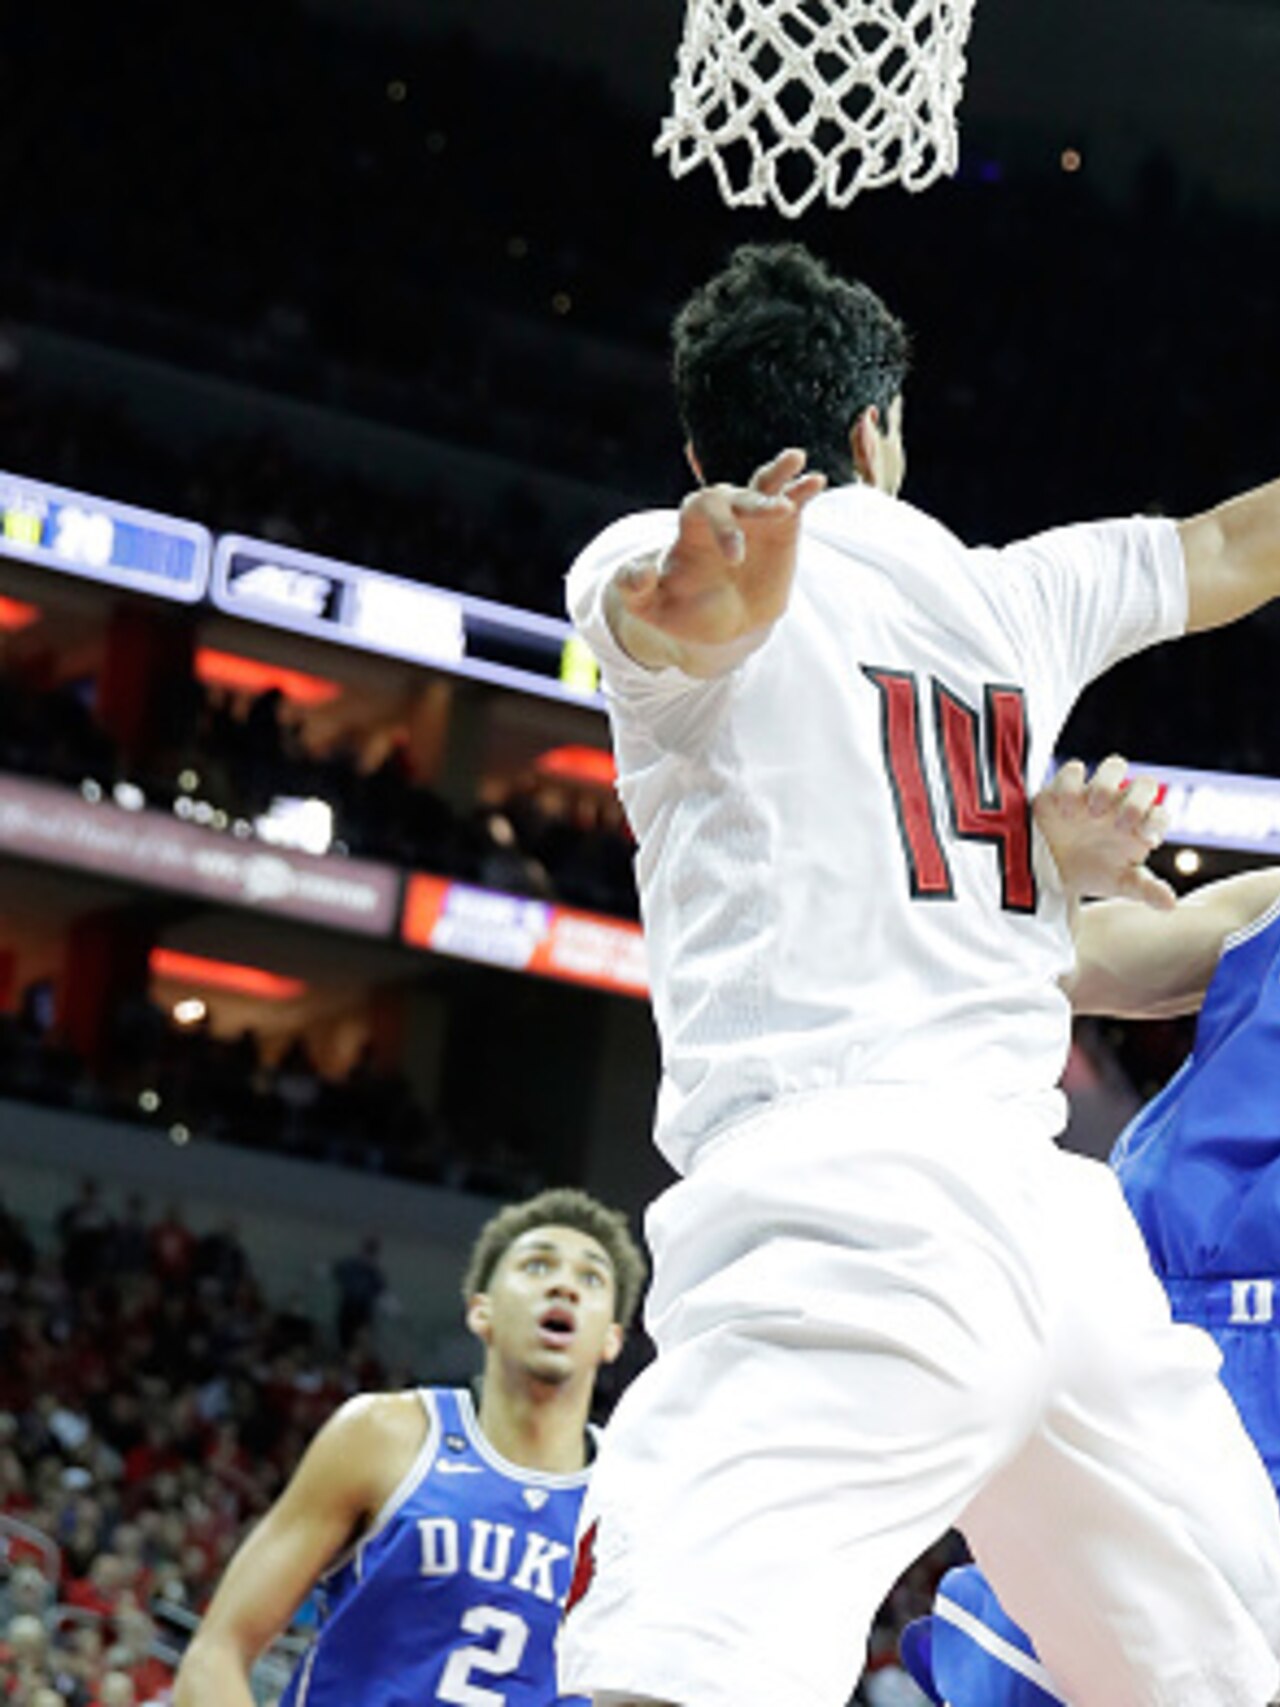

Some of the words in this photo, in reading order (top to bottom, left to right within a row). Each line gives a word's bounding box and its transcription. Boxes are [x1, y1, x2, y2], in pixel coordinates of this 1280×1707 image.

[858, 662, 1037, 915] 14
[417, 1517, 569, 1609] DUK
[435, 1605, 531, 1707] 2
